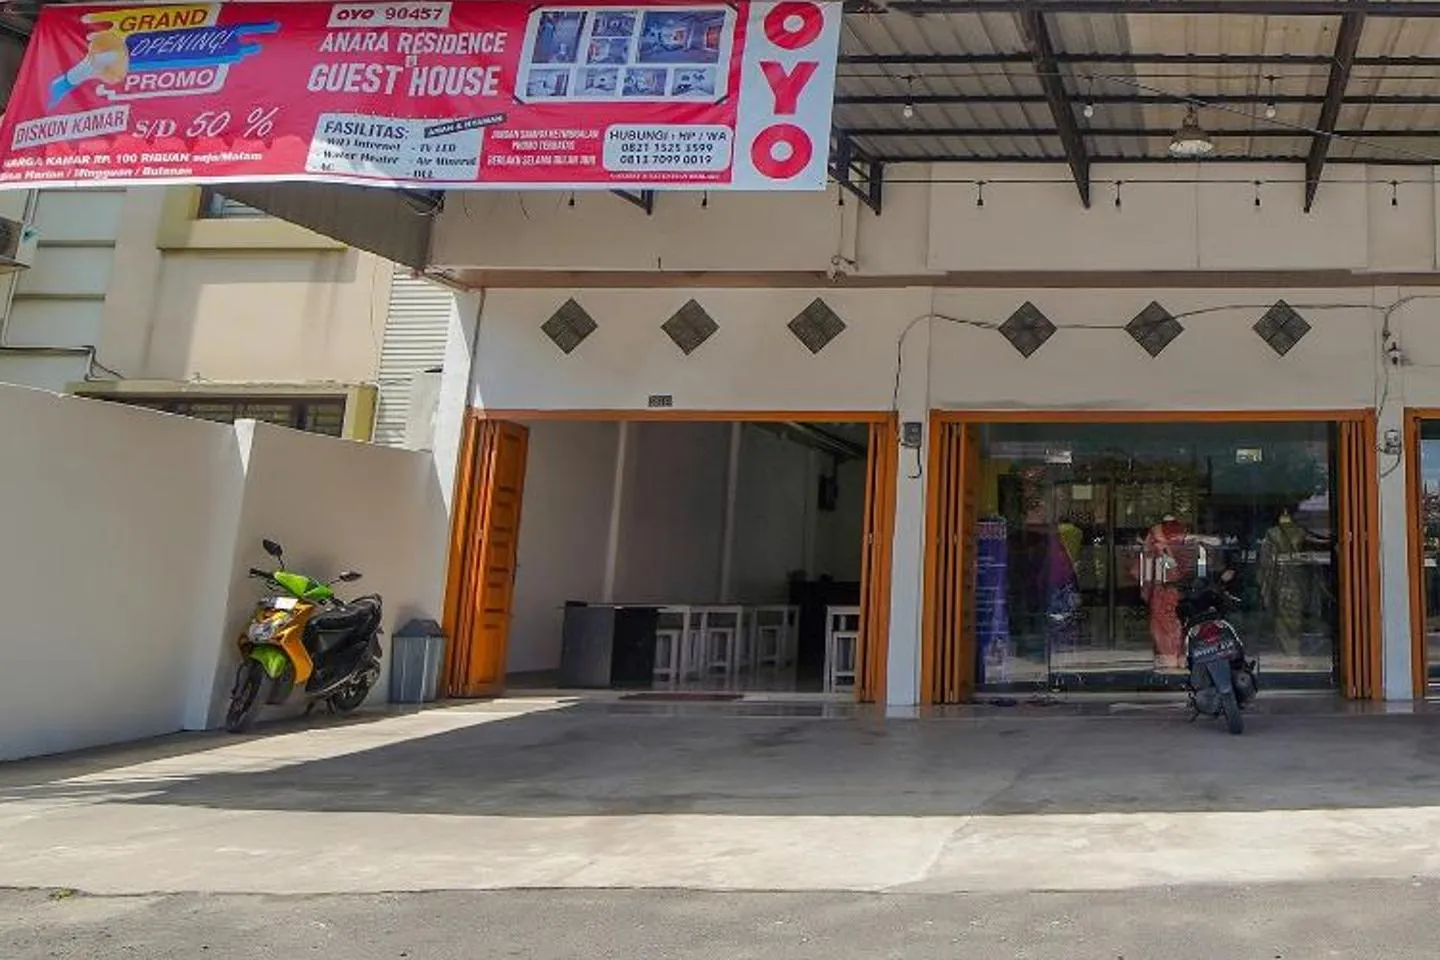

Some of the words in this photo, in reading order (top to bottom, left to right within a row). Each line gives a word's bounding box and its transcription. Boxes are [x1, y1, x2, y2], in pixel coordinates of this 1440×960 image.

[119, 8, 208, 32] GRAND
[337, 8, 374, 20] OYO
[385, 7, 442, 20] 90457
[130, 29, 236, 56] OPENING!
[319, 32, 389, 53] ANARA
[397, 32, 508, 55] RESIDENCE
[124, 69, 214, 91] PROMO
[307, 63, 404, 95] GUEST
[408, 66, 503, 96] HOUSE
[16, 120, 69, 145] DISKON
[71, 111, 125, 134] KAMAR
[187, 110, 231, 138] 50
[243, 107, 280, 138] %
[324, 120, 410, 140] FASILITAS:
[609, 130, 668, 141] HUBUNGI
[46, 155, 91, 166] KAMAR
[116, 153, 138, 164] 100
[141, 152, 190, 163] RIBUAN
